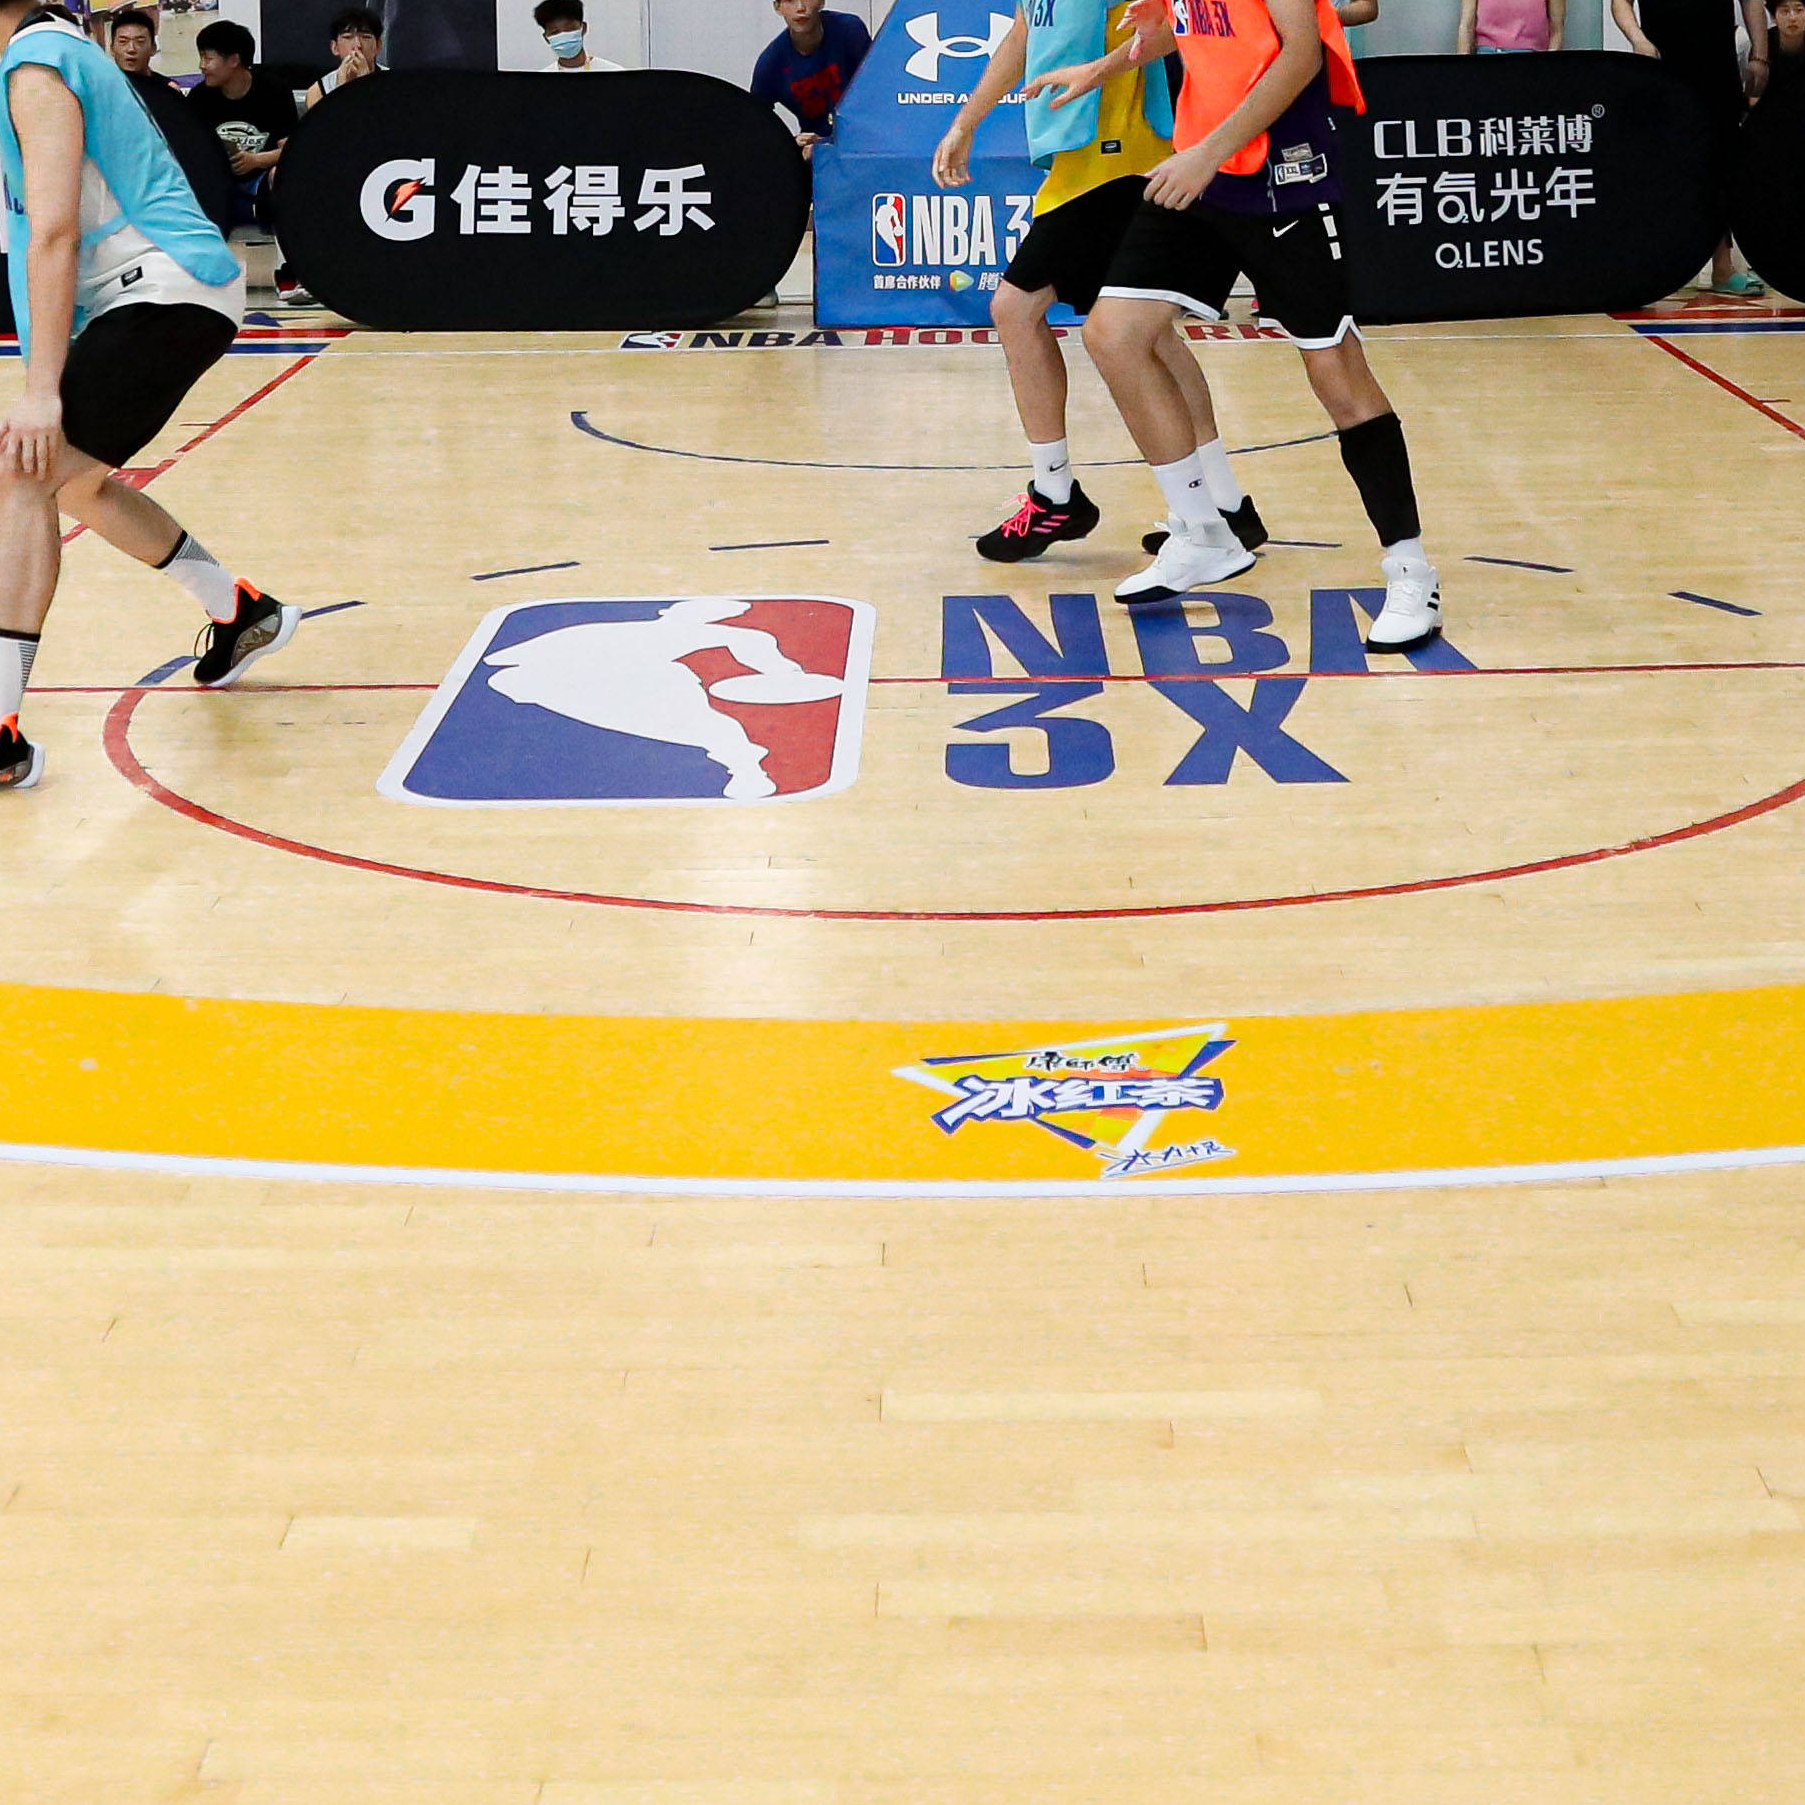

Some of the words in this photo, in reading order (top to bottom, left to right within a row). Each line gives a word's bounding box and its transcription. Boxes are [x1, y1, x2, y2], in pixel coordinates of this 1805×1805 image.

[897, 92, 954, 105] UNDER
[1374, 119, 1472, 161] CLB
[450, 163, 716, 237] 佳得乐
[912, 195, 997, 266] NBA
[1005, 195, 1038, 264] 3
[689, 331, 843, 347] NBA
[941, 588, 1480, 678] NBA
